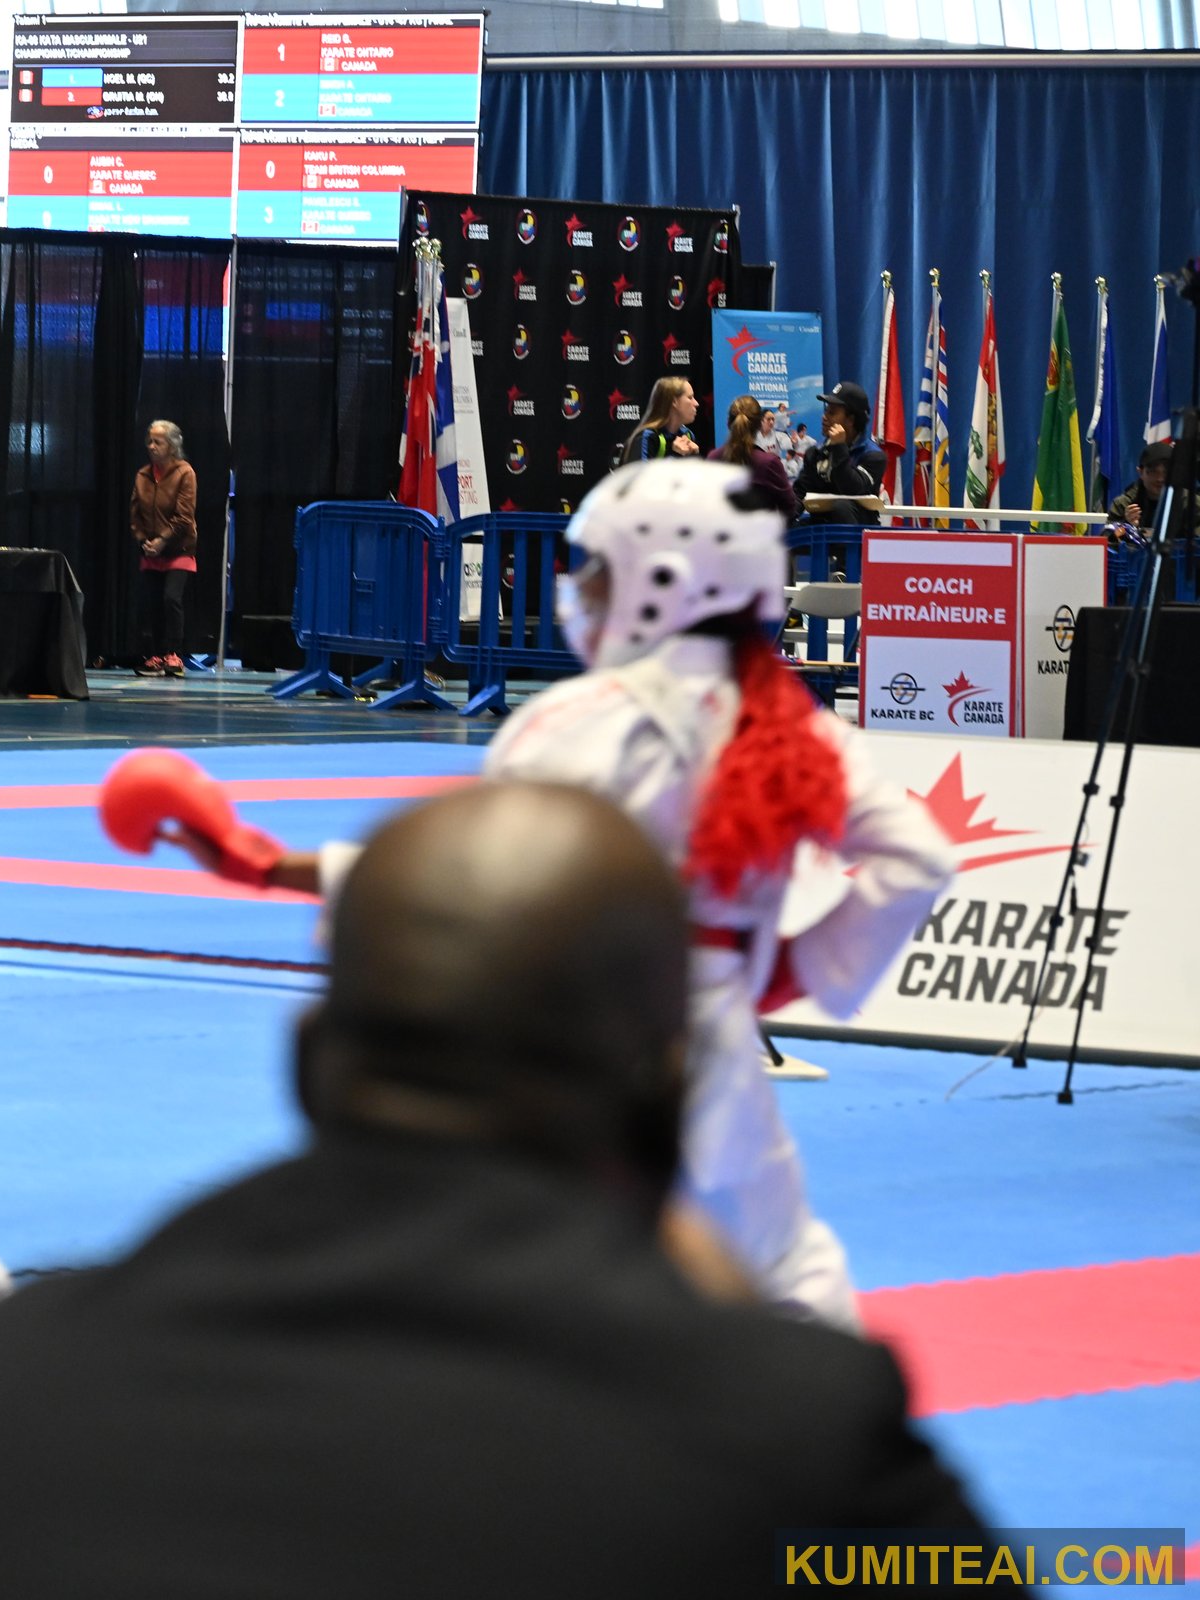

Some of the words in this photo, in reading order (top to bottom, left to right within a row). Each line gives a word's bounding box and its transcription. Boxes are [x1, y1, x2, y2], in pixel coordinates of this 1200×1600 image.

[40, 34, 61, 46] KATA
[277, 44, 285, 61] 1
[321, 47, 355, 58] KARATE
[356, 47, 394, 58] ONTARIO
[341, 61, 377, 71] CANADA
[275, 90, 285, 107] 2
[44, 165, 53, 184] 0
[90, 170, 123, 181] KARATE
[265, 160, 275, 179] 0
[109, 183, 144, 194] CANADA
[324, 178, 359, 189] CANADA
[747, 352, 787, 365] KARATE
[748, 363, 788, 375] CANADA
[749, 382, 789, 392] NATIONAL
[905, 577, 973, 595] COACH
[1038, 660, 1069, 675] KARAT
[964, 701, 1004, 714] KARATE
[871, 708, 917, 721] KARATE
[920, 710, 934, 721] BC
[964, 712, 1004, 725] CANADA
[913, 898, 1131, 956] KARATE
[897, 952, 1107, 1011] CANADA
